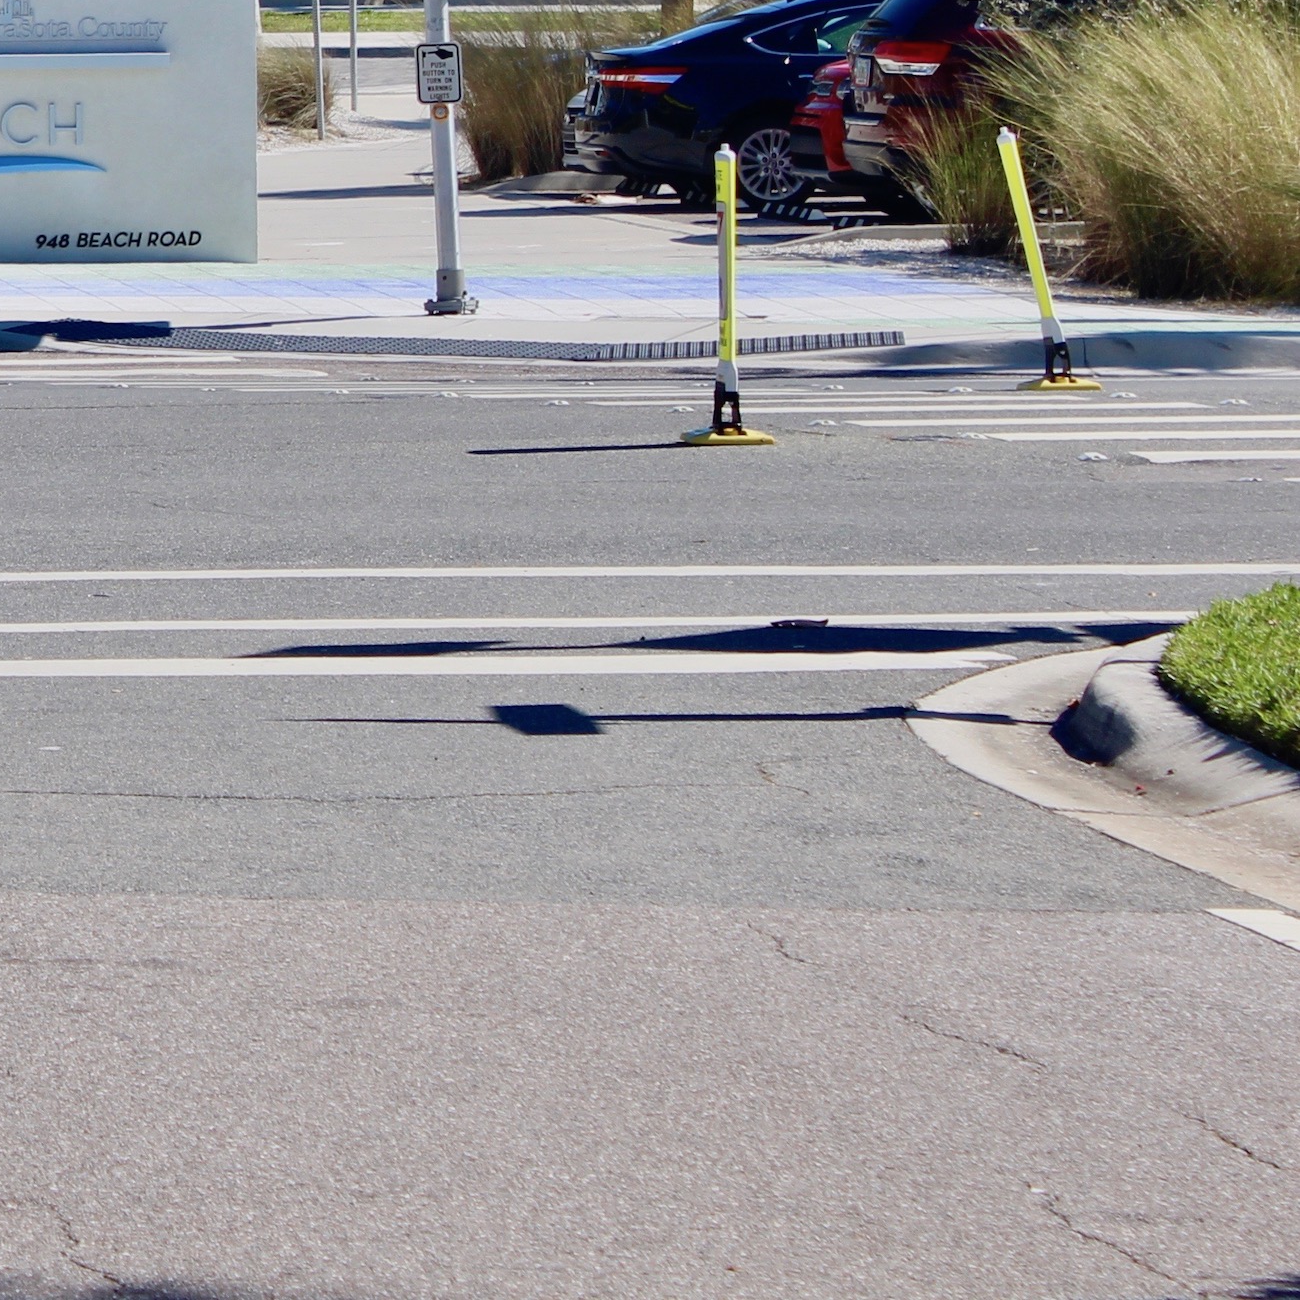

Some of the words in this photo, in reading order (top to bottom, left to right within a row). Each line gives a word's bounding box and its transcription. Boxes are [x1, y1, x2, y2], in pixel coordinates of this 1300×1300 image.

[77, 15, 168, 42] County
[35, 233, 70, 249] 948
[76, 231, 143, 248] BEACH
[147, 230, 203, 247] ROAD
